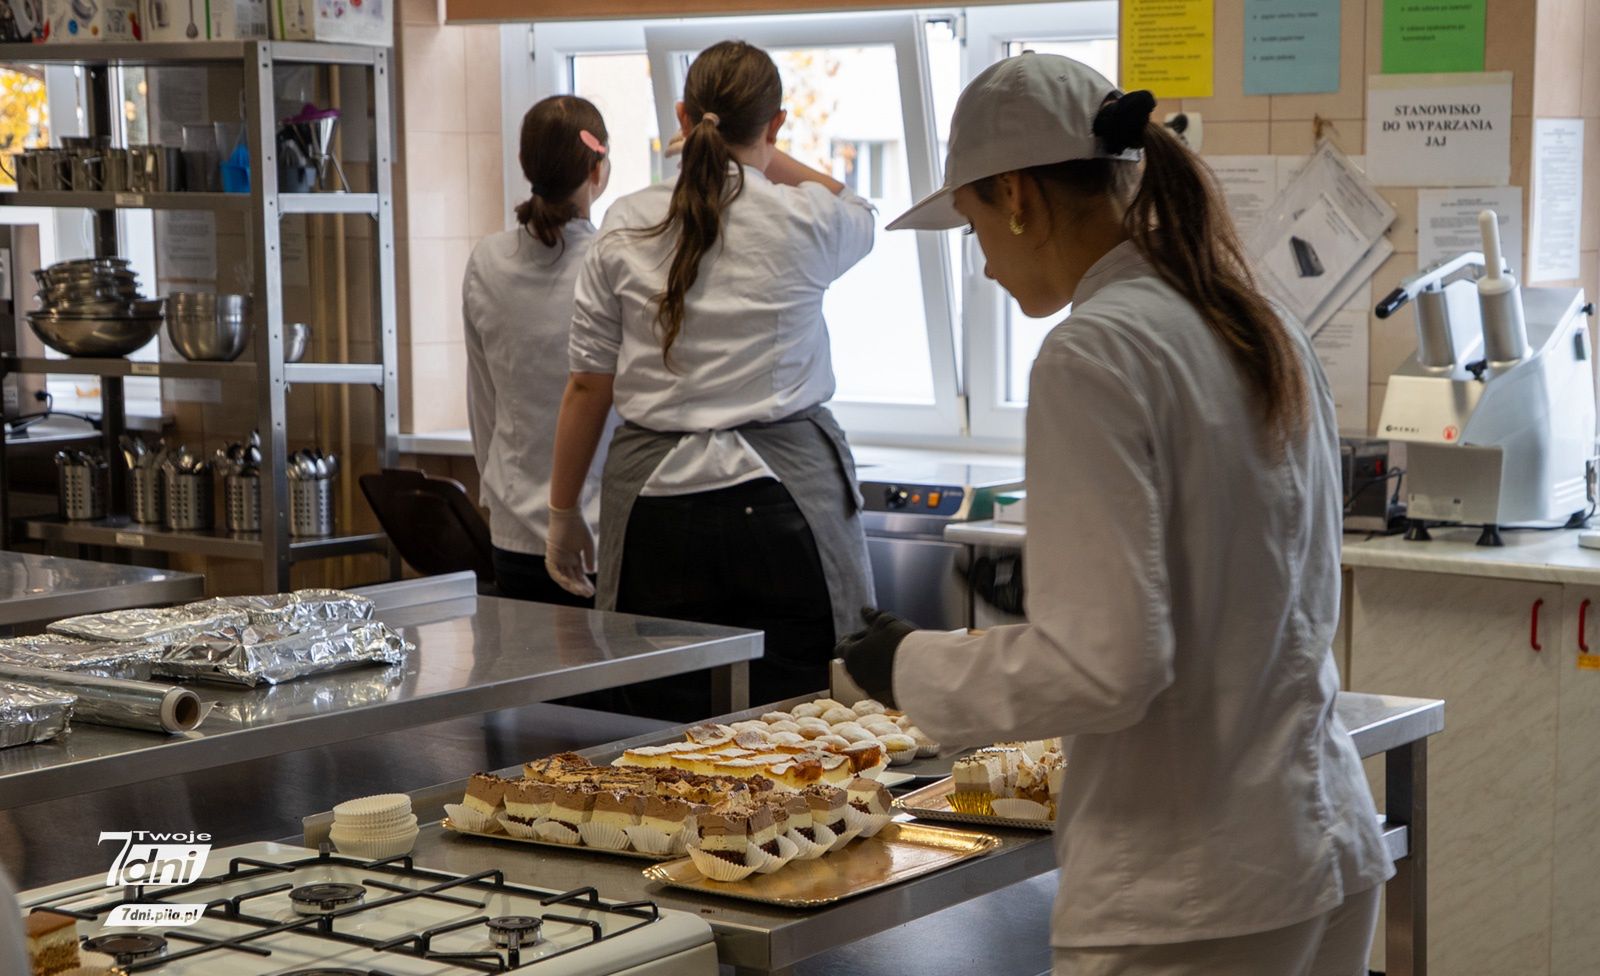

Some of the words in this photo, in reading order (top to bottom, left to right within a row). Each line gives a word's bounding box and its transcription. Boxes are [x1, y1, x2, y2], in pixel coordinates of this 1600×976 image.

[1394, 104, 1481, 116] STANOWISKO
[1382, 120, 1401, 132] DO
[1406, 119, 1493, 131] WYPARZANIA
[1425, 136, 1447, 147] JAJ
